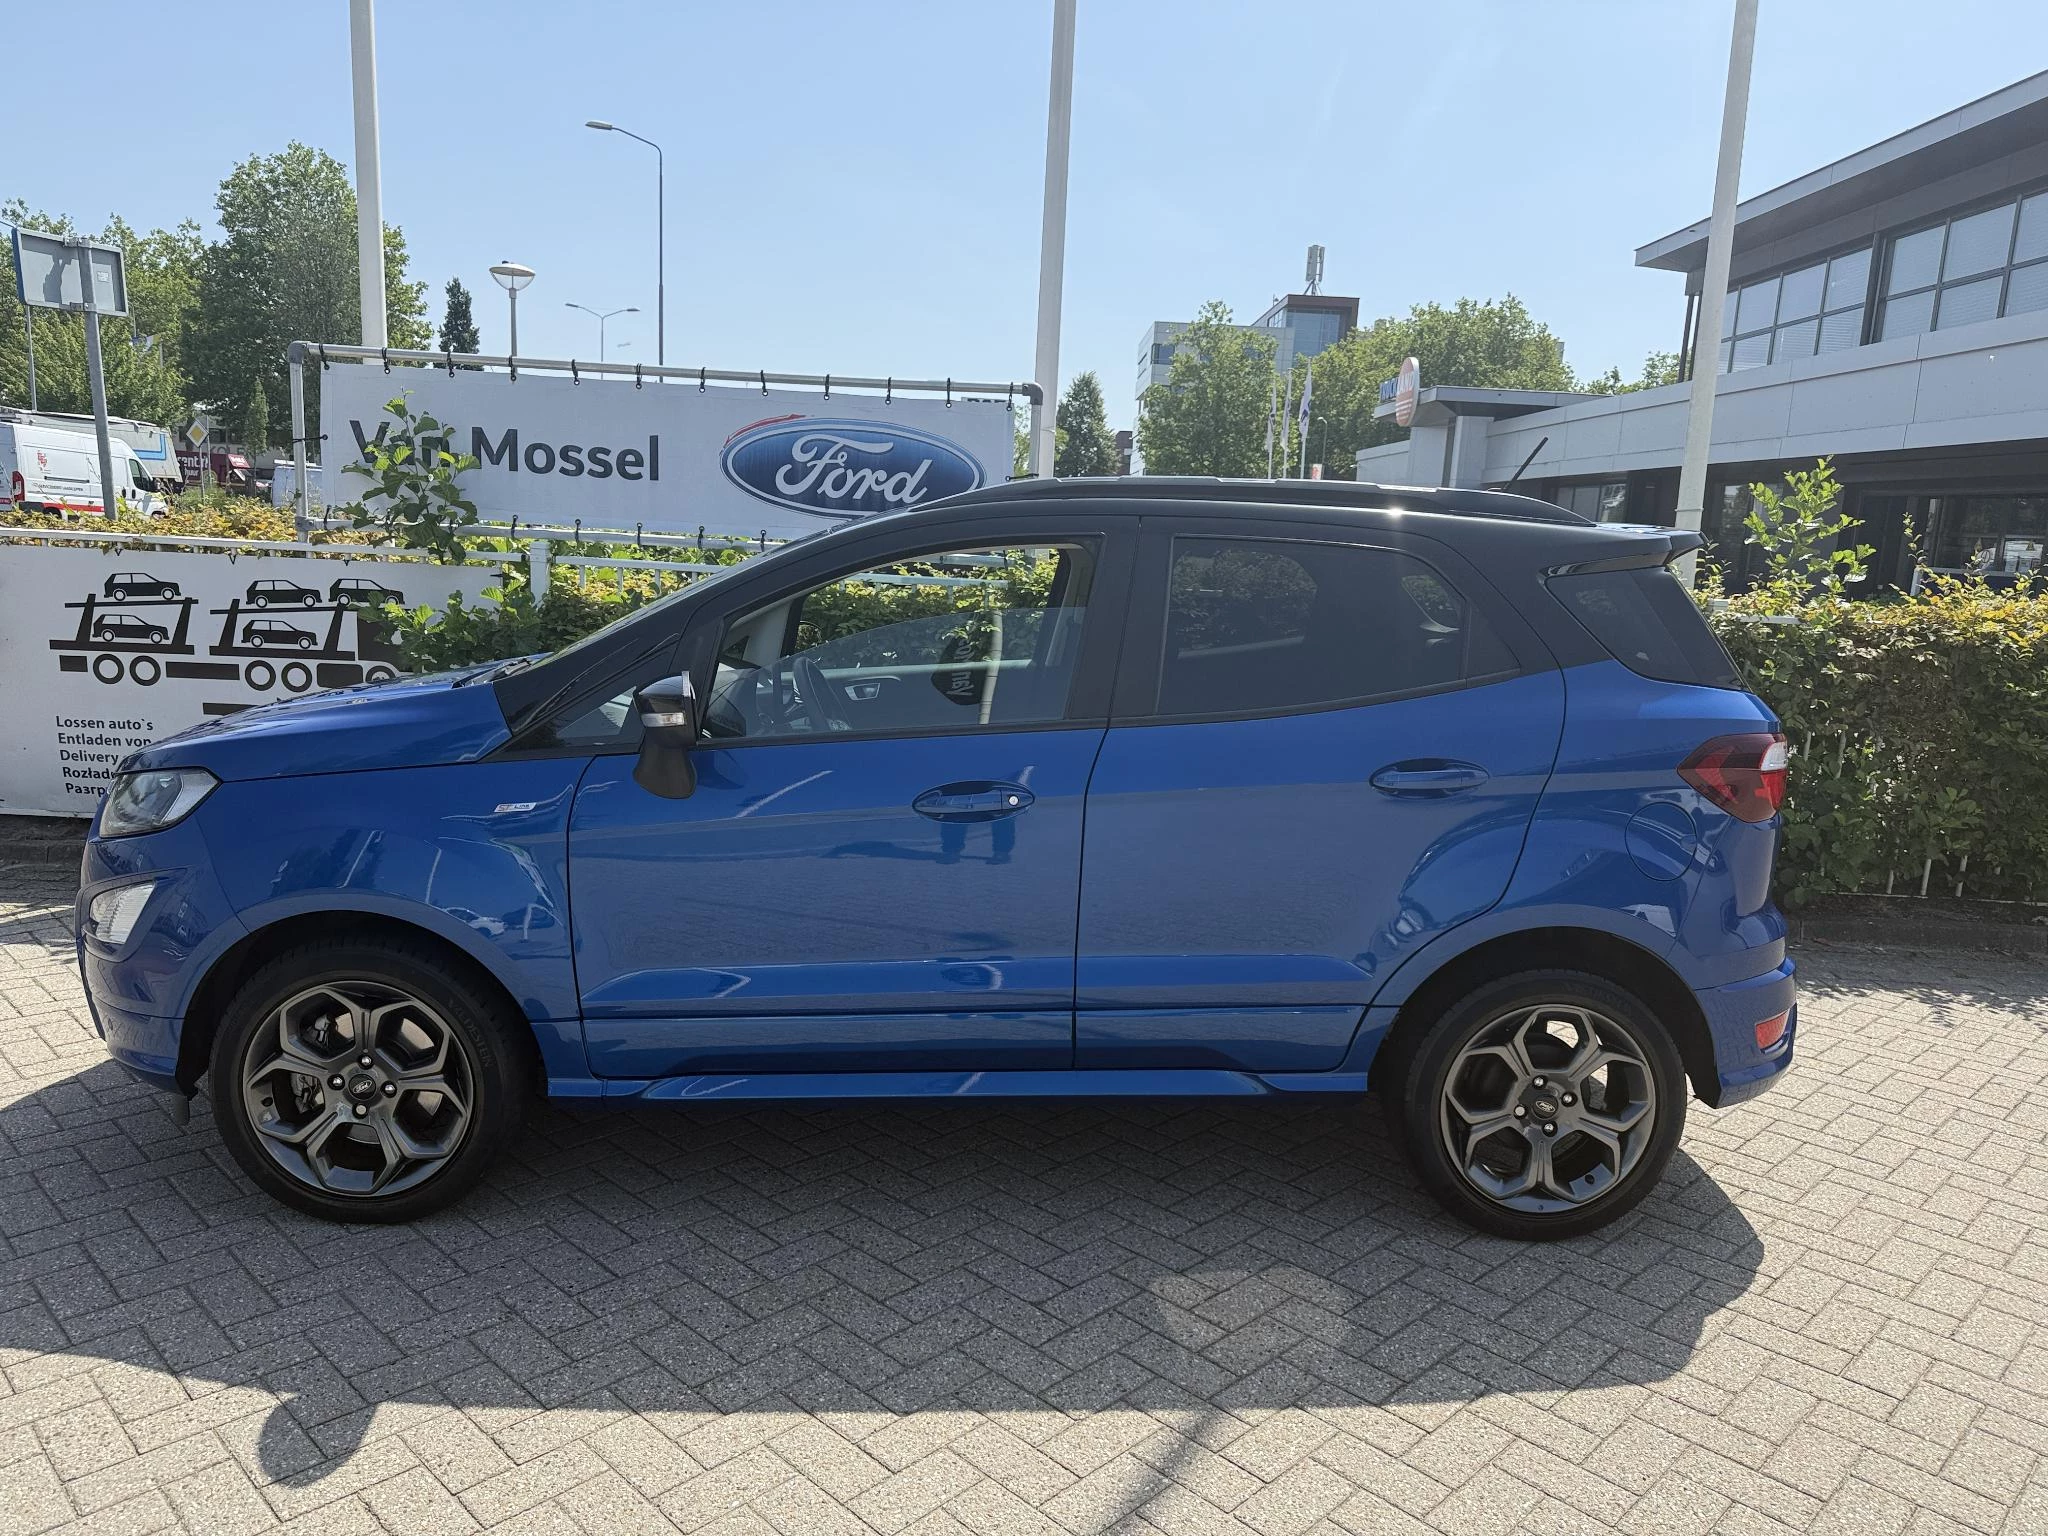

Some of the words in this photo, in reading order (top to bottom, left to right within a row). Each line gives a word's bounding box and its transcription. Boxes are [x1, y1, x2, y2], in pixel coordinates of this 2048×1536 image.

[471, 427, 659, 481] Mossel
[775, 434, 932, 504] Ford
[56, 716, 105, 729] Lossen
[58, 732, 122, 747] Entladen
[60, 750, 119, 765] Delivery
